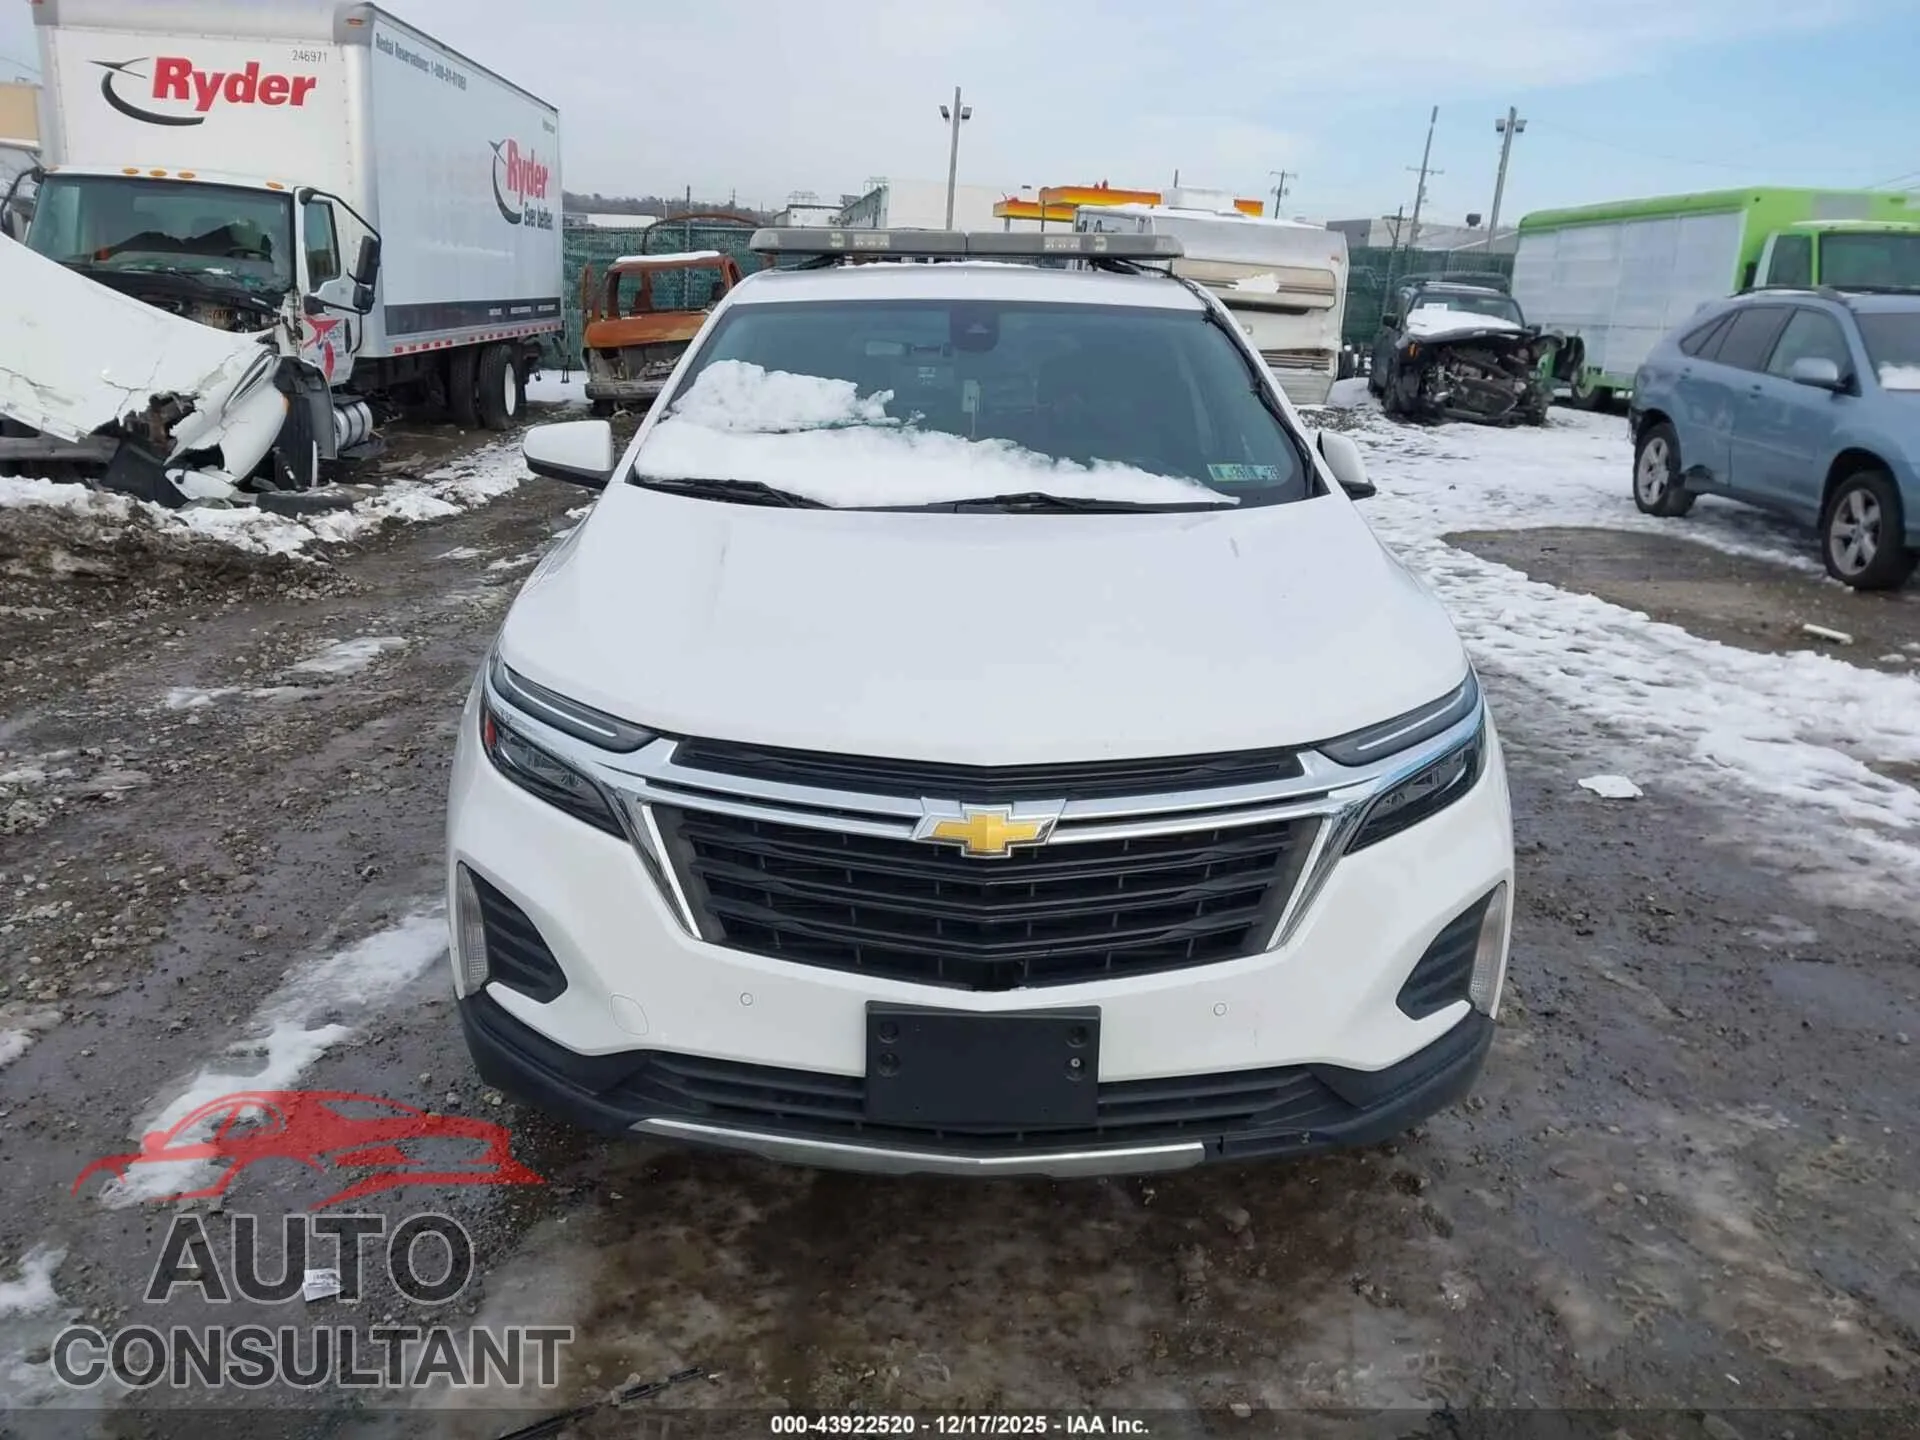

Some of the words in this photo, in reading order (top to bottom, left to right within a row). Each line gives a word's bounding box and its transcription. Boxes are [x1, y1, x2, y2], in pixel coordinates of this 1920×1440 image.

[152, 56, 317, 112] Ryder
[292, 49, 328, 63] 246971
[507, 138, 549, 206] Ryder
